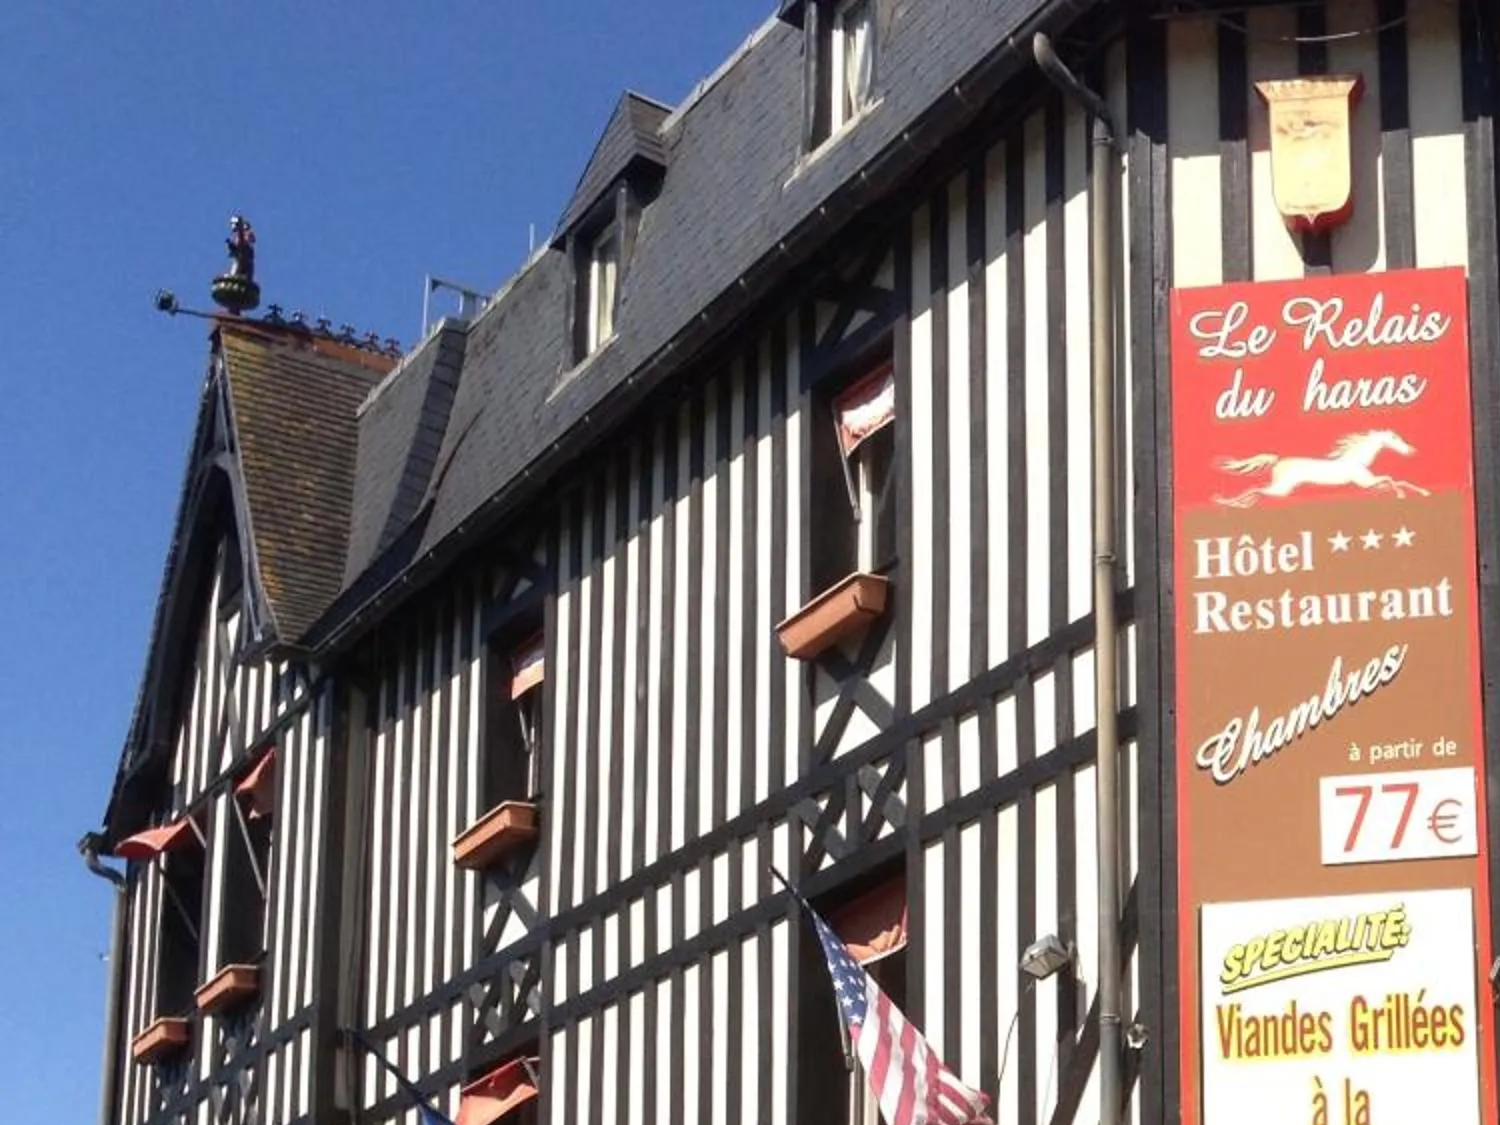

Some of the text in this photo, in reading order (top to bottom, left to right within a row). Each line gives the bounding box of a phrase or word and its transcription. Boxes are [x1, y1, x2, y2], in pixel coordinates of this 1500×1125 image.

[1190, 292, 1450, 358] Le Relais
[1215, 358, 1427, 419] du haras
[1195, 531, 1315, 578] Hôtel
[1194, 577, 1454, 635] Restaurant
[1196, 643, 1409, 785] Chambres
[1348, 738, 1457, 766] à partir de
[1335, 782, 1464, 853] 77€
[1216, 988, 1465, 1060] Viandes Grillées
